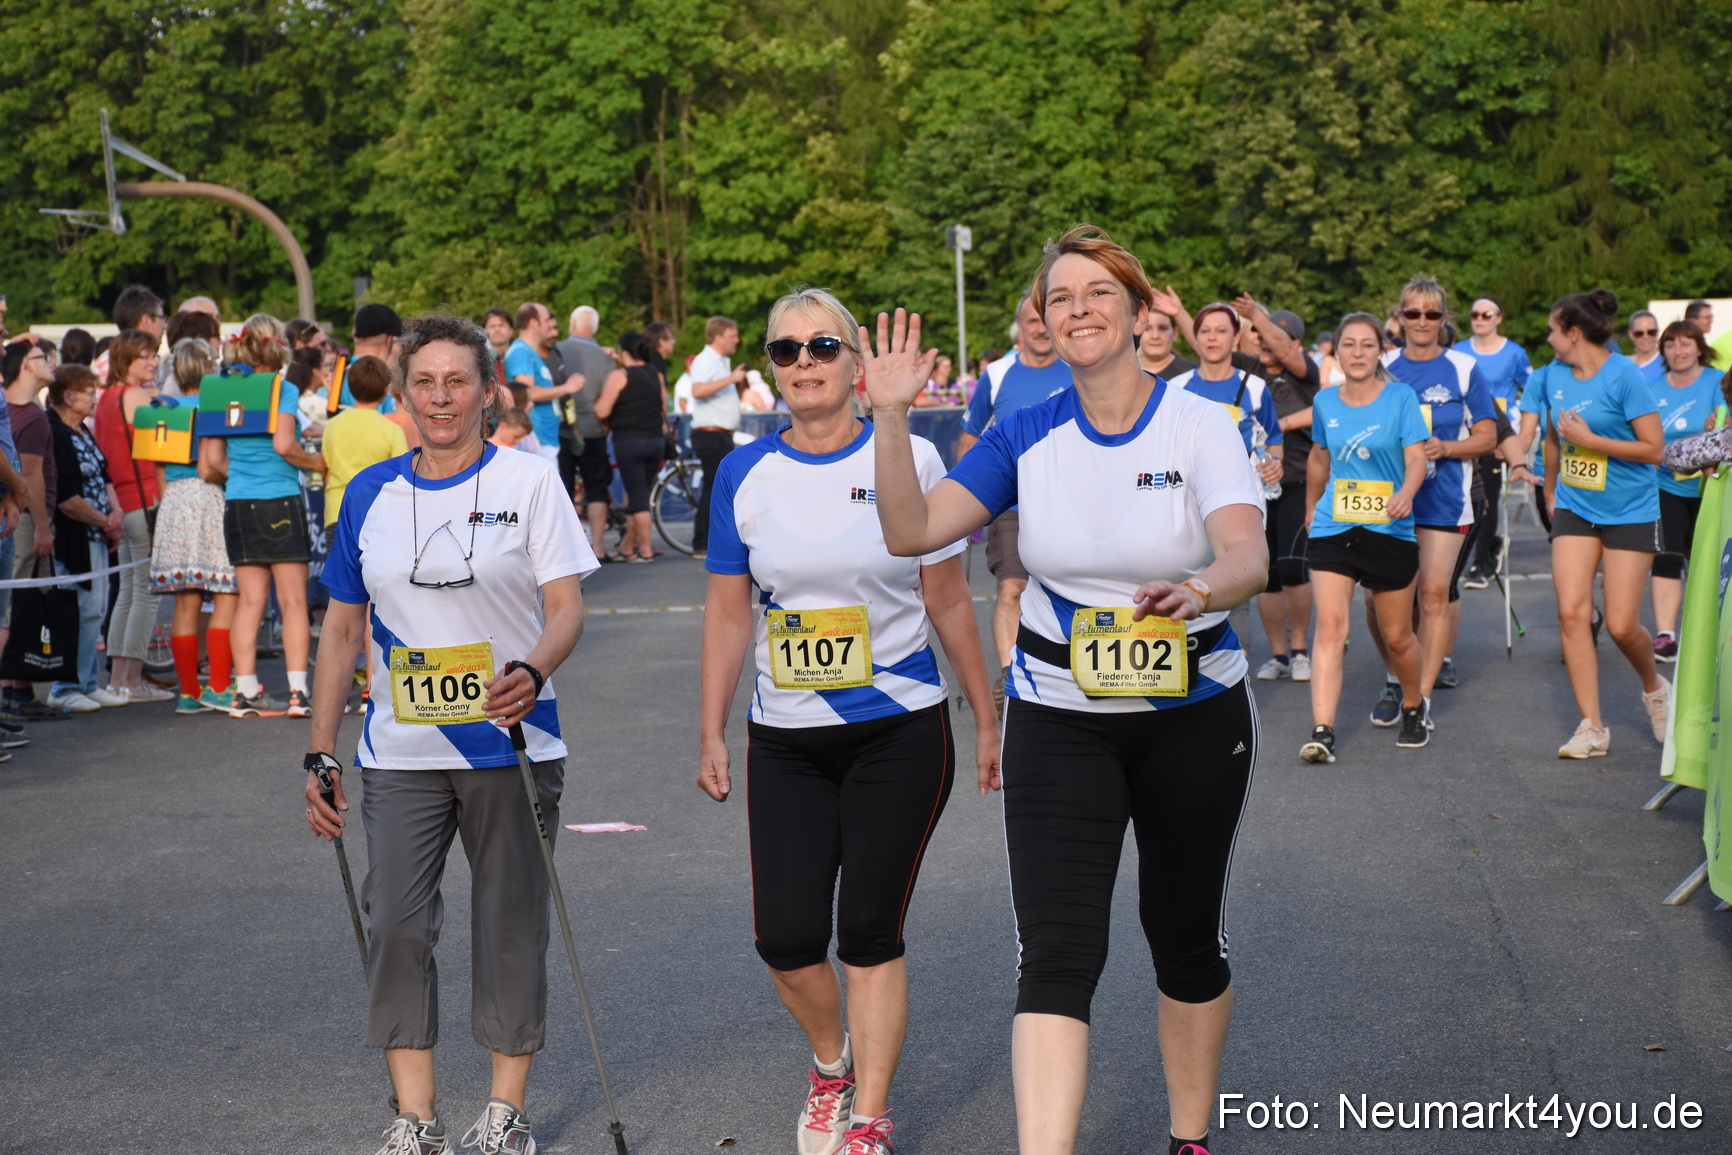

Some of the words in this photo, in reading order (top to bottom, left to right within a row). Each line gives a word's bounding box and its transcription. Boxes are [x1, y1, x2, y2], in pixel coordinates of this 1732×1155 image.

[1565, 458, 1598, 478] 1528
[851, 487, 877, 501] iRE
[1341, 495, 1384, 511] 1533
[780, 625, 817, 633] firmenlauf
[821, 627, 841, 637] walk
[842, 627, 862, 636] 2019
[1087, 624, 1133, 633] firmenlauf
[1138, 628, 1158, 638] walk
[1159, 631, 1180, 639] 2019
[780, 636, 855, 668] 1107
[1085, 639, 1172, 671] 1102
[403, 662, 441, 672] firmenlauf
[446, 664, 465, 674] walk
[467, 664, 486, 673] 2019
[823, 668, 842, 676] Anja
[1097, 672, 1134, 681] Fiederer
[1136, 672, 1161, 682] Tanja
[403, 673, 481, 703] 1106
[415, 704, 441, 712] Körner
[443, 703, 470, 713] Conny
